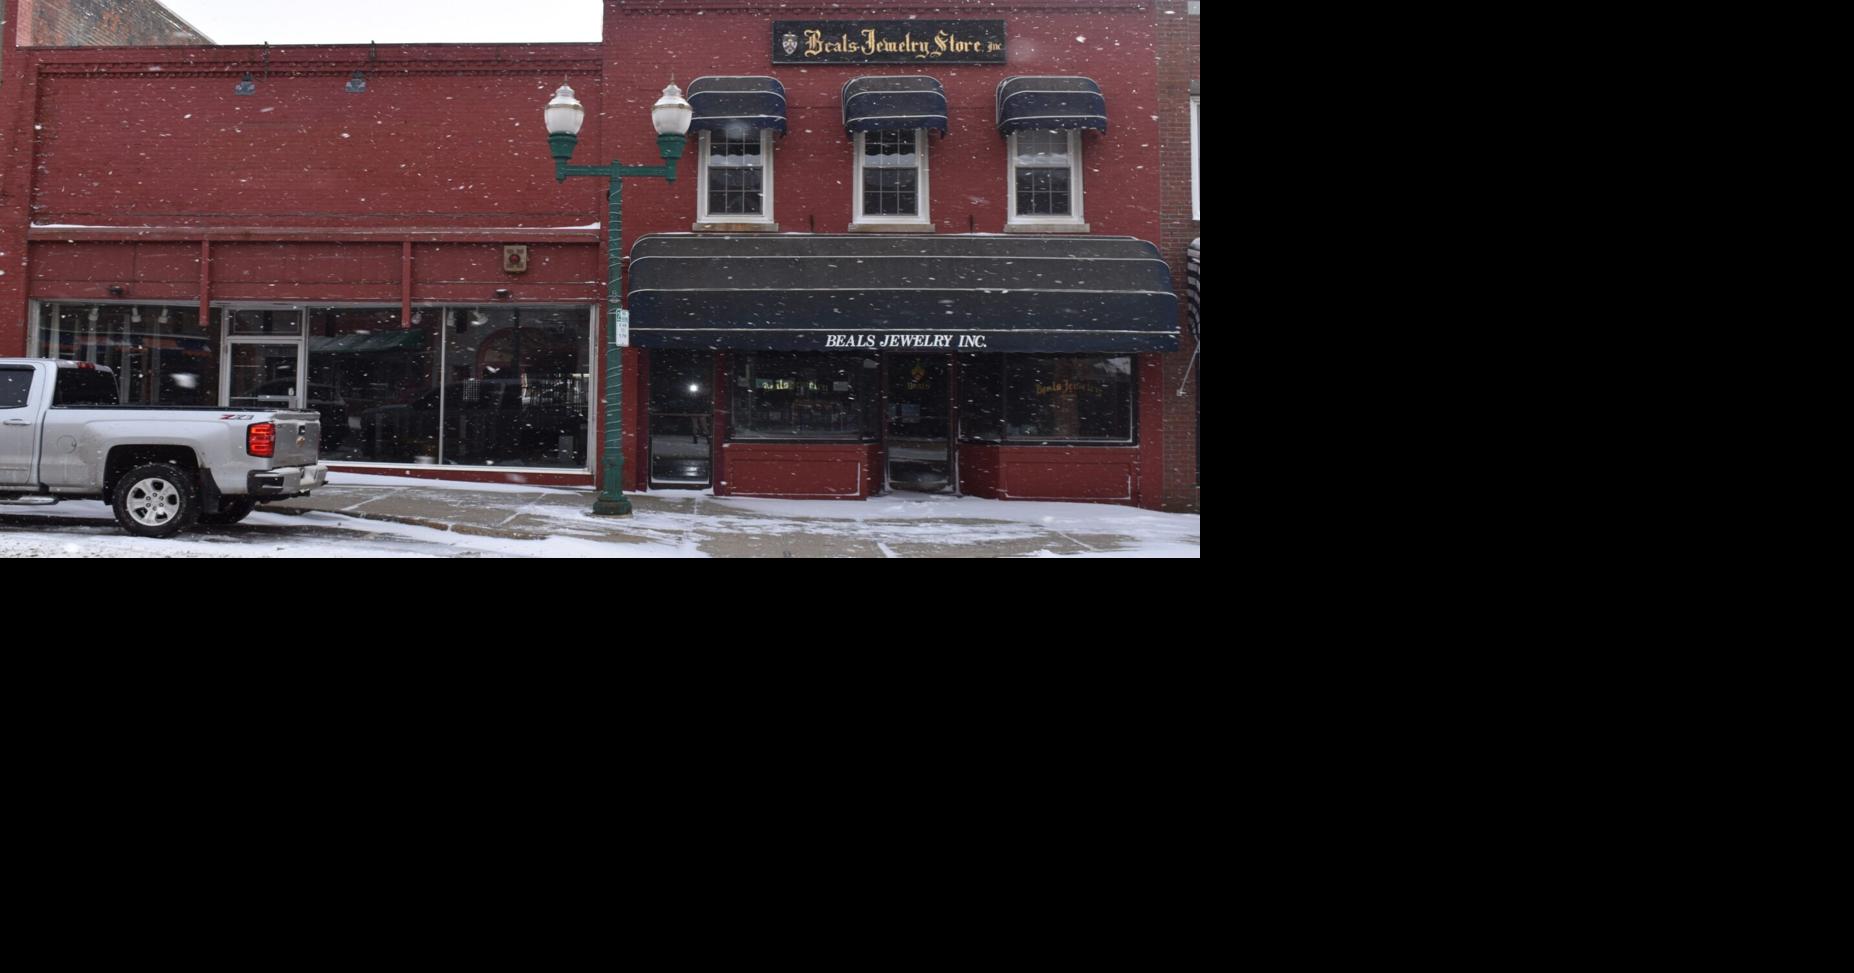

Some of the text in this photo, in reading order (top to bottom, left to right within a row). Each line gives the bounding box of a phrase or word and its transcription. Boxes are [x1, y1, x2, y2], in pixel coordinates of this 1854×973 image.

[861, 28, 929, 58] Jewelry
[825, 334, 987, 348] BEALS JEWELRY INC.
